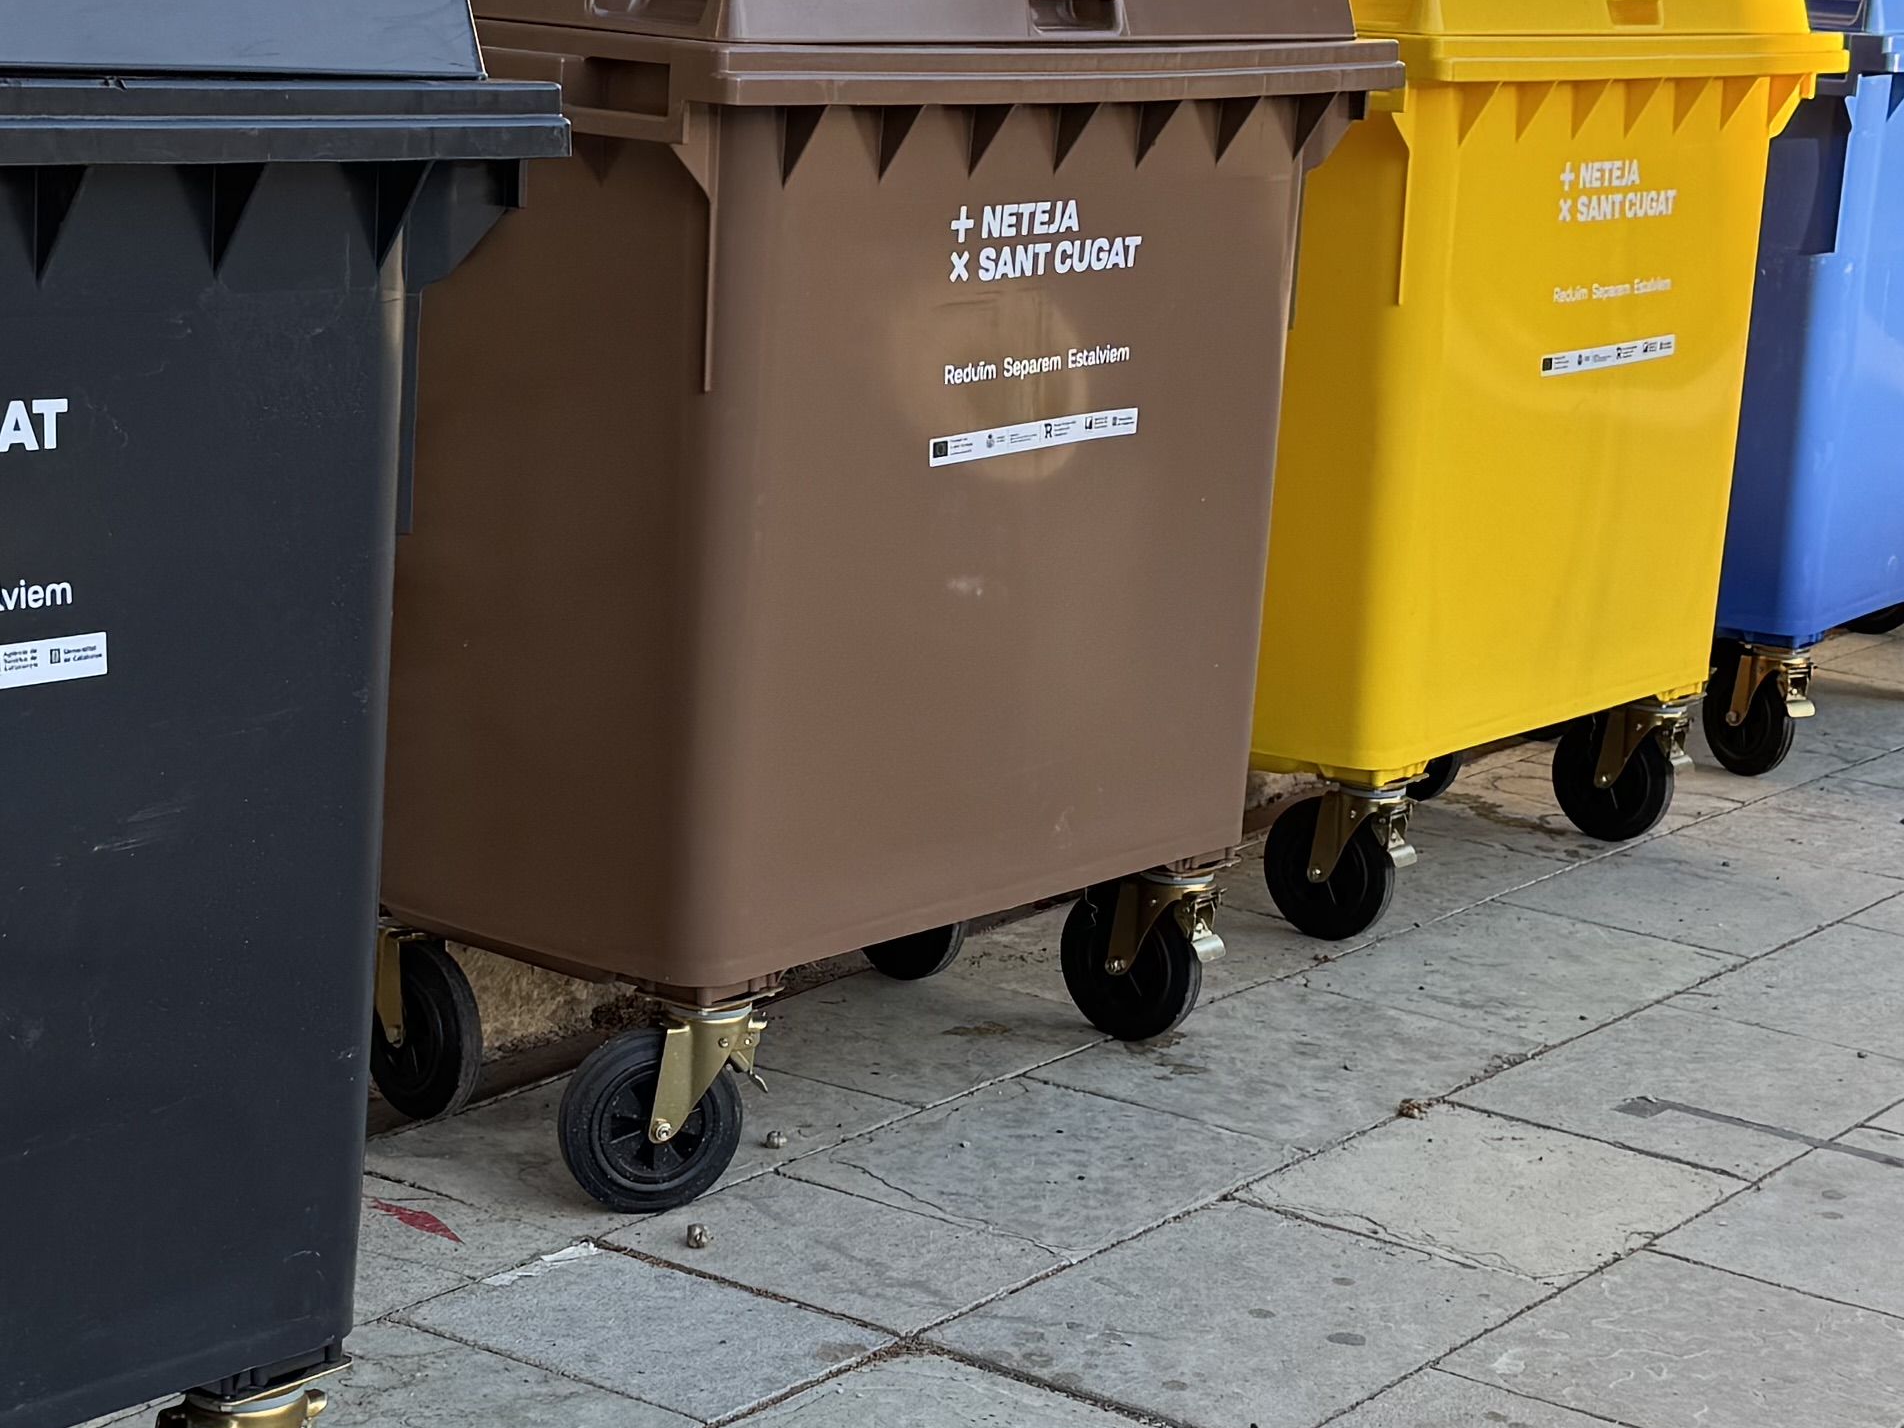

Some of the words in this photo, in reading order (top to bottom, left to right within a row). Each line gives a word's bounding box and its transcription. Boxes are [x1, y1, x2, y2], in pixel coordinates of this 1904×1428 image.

[1580, 159, 1641, 189] NETEJA
[981, 199, 1079, 239] NETEJA
[1578, 195, 1623, 221] SANT
[1625, 189, 1678, 219] CUGAT
[978, 242, 1052, 281] SANT
[1054, 235, 1142, 274] CUGAT
[1003, 355, 1062, 380] Separem
[1067, 344, 1130, 369] Estalviem
